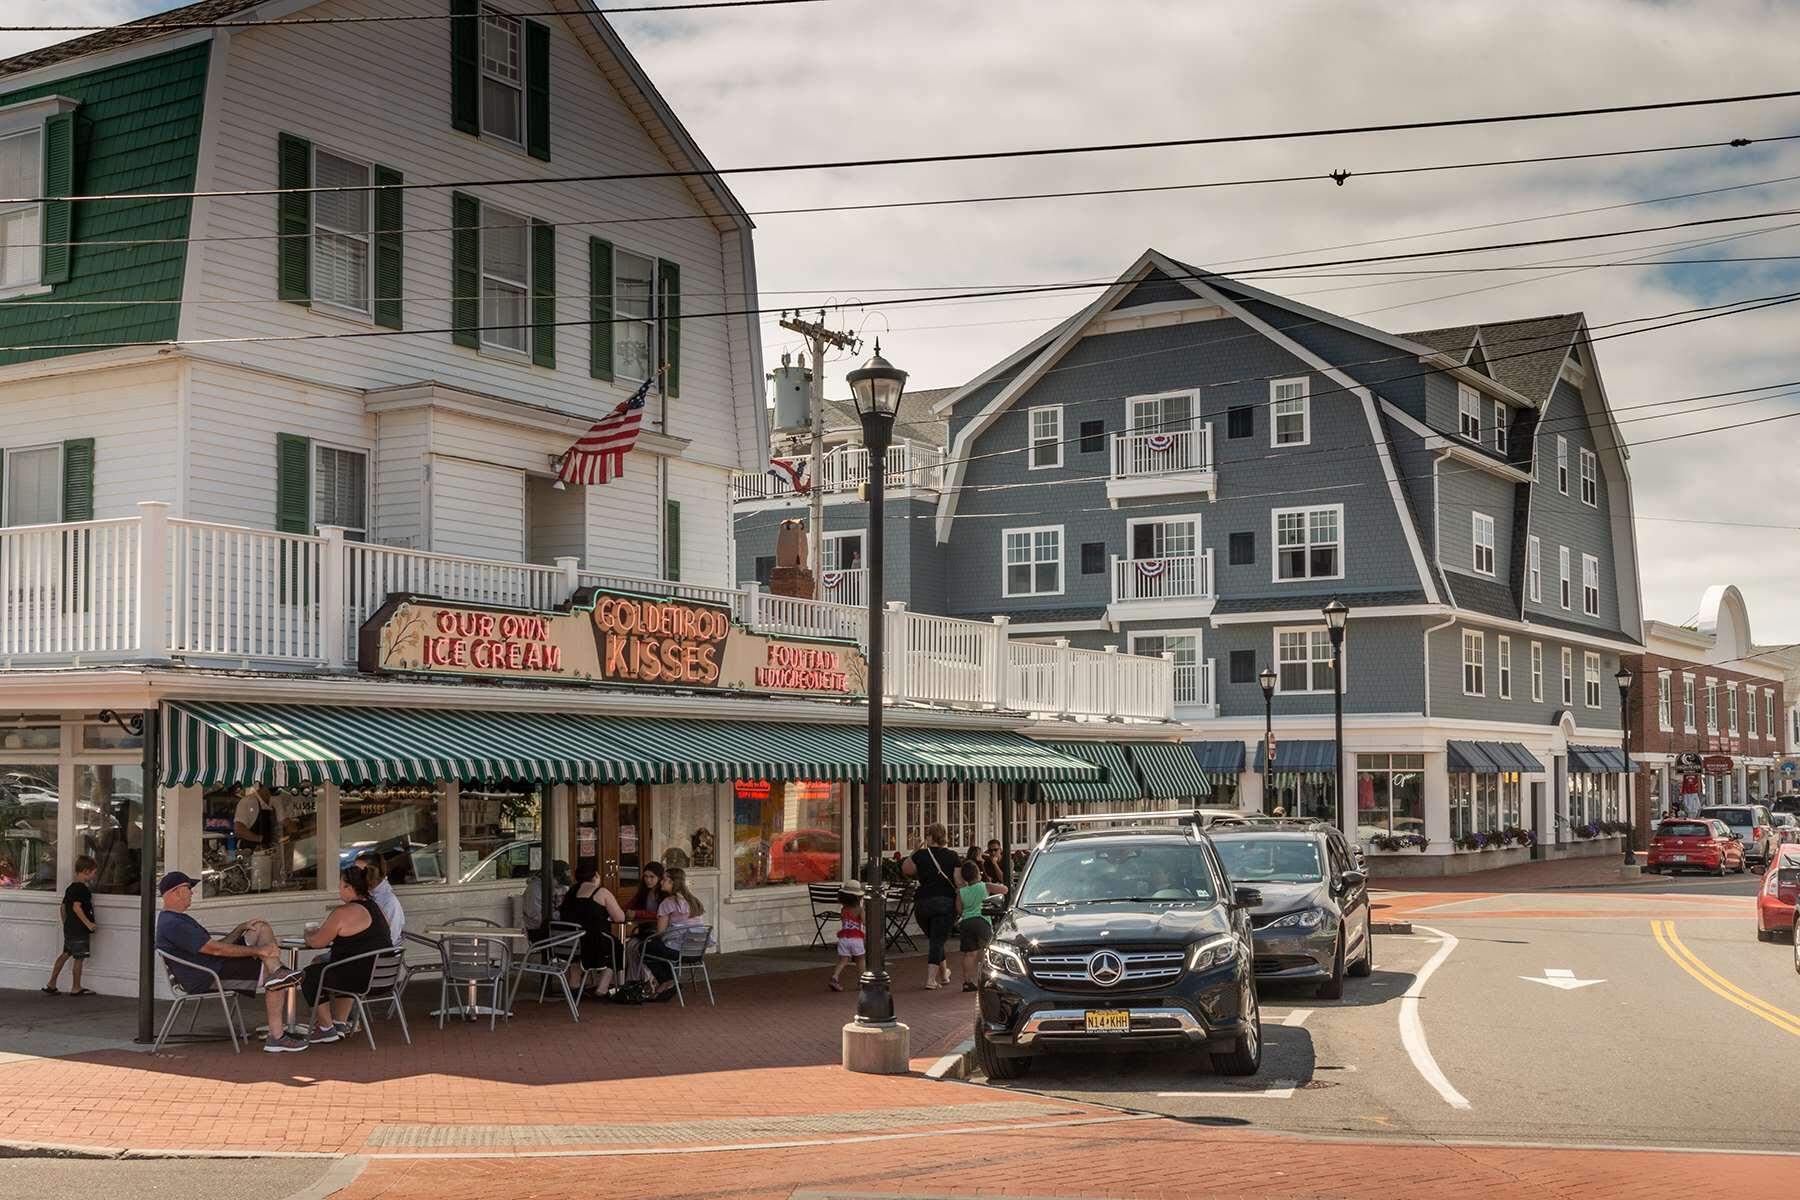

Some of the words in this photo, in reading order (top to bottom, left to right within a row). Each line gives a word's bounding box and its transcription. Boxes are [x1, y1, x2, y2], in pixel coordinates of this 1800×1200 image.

[437, 610, 496, 637] OUR
[500, 615, 551, 641] OWN
[594, 596, 729, 642] GOLDENROD
[423, 635, 469, 667] ICE
[470, 639, 561, 673] CREAM
[606, 635, 719, 683] KISSES
[767, 645, 840, 671] FOUNTAIN
[755, 666, 850, 694] LUNCHEONETTE
